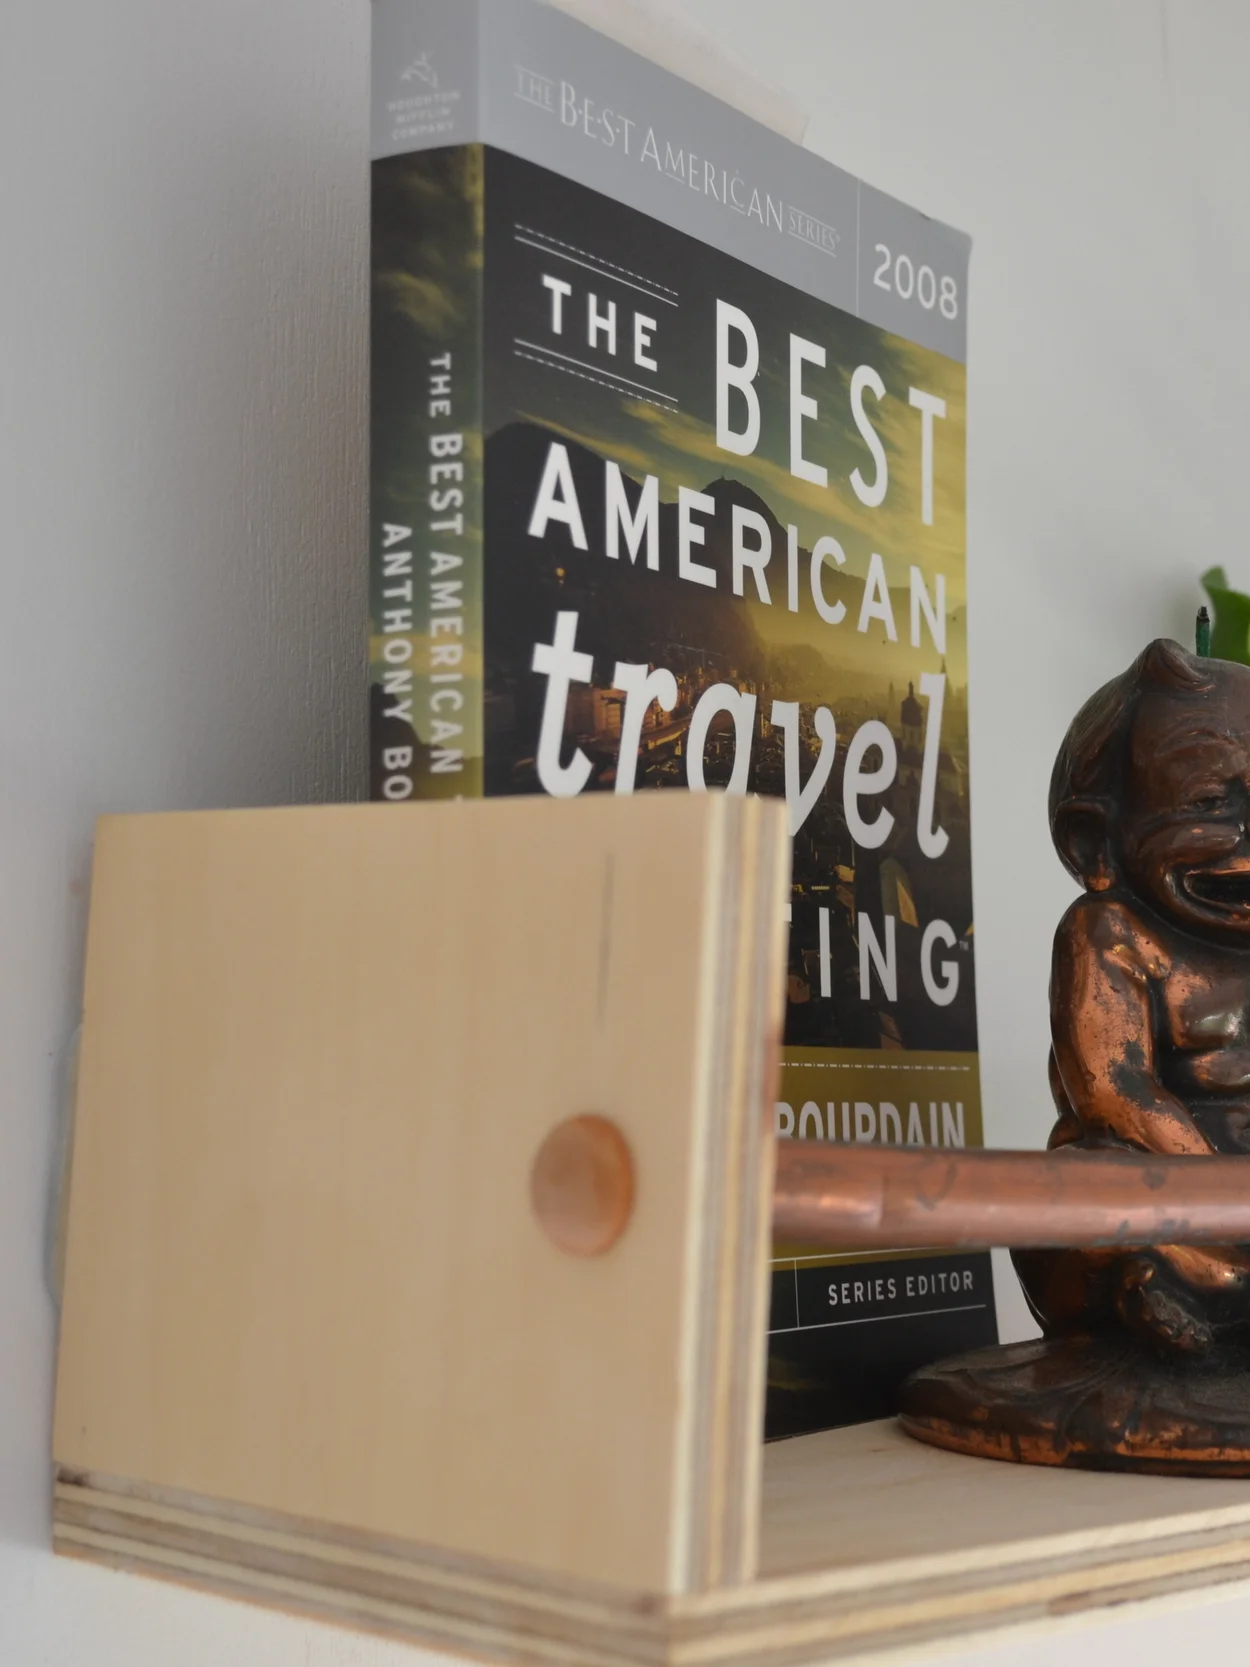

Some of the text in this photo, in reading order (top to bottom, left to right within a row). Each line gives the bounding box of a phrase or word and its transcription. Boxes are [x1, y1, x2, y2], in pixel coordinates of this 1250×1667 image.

[641, 126, 783, 233] AMERICAN
[873, 243, 959, 321] 2008
[541, 273, 947, 525] THE BEST
[382, 522, 413, 722] ANTHONY
[428, 352, 464, 774] THE BEST AMERICAN
[527, 441, 947, 655] AMERICAN
[531, 610, 950, 860] travel
[828, 1270, 974, 1306] SERIES EDITOR
